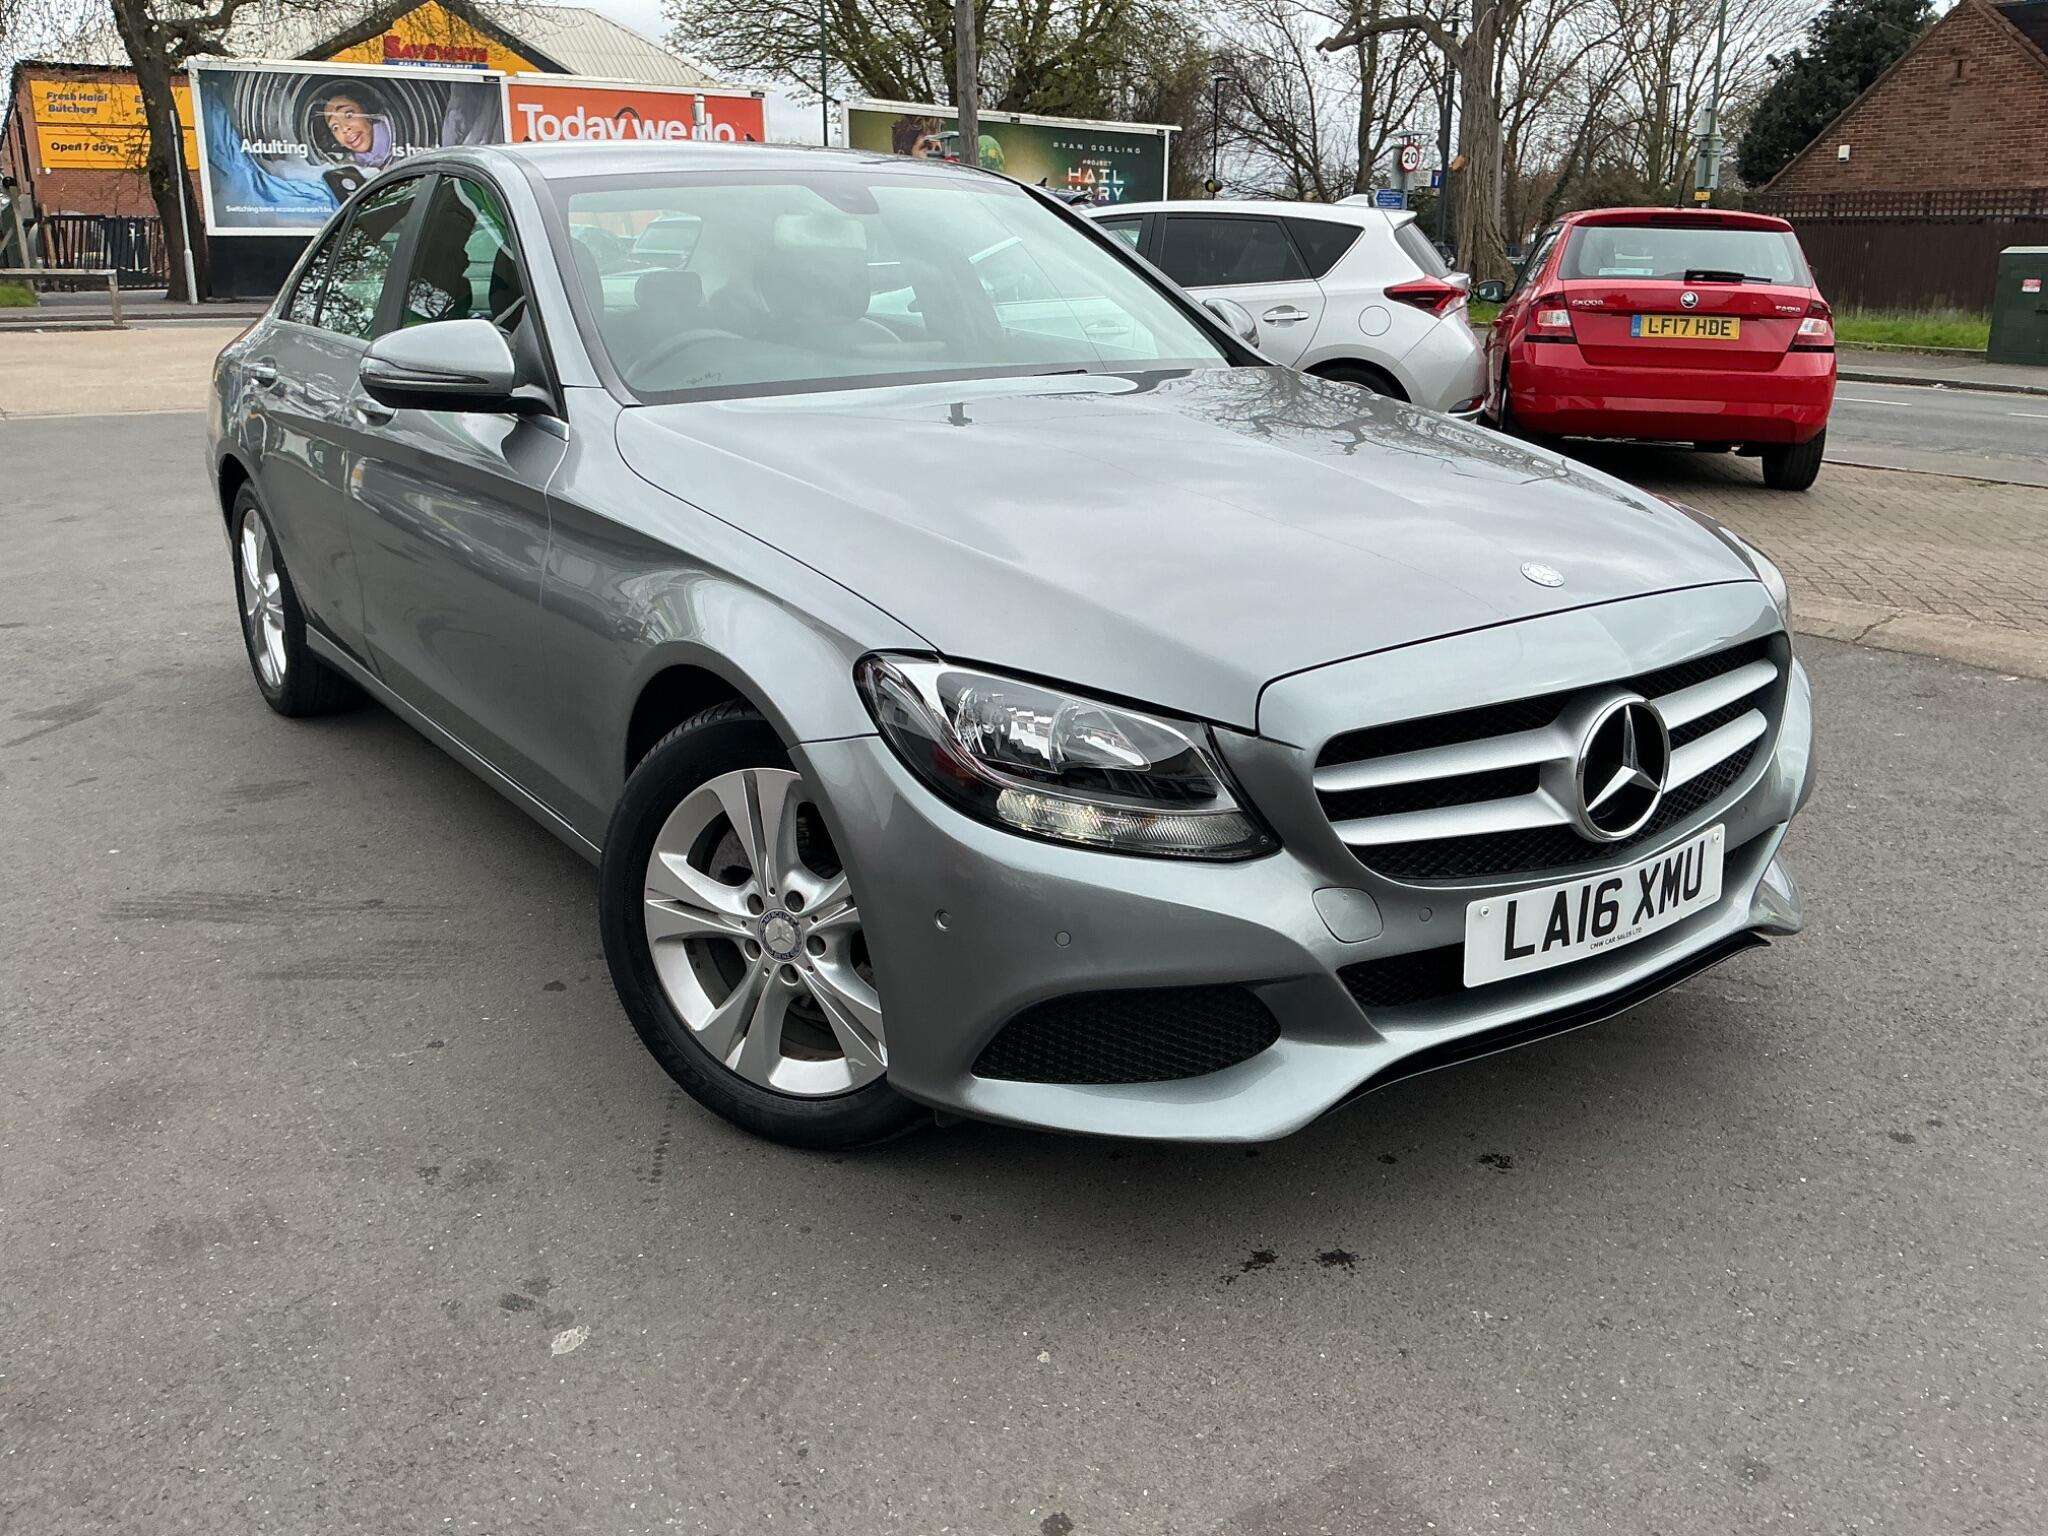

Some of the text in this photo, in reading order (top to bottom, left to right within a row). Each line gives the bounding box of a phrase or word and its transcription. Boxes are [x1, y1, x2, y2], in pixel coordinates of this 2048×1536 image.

[46, 91, 107, 102] Fresh Halal
[48, 104, 98, 114] Butchers
[517, 103, 628, 141] Today
[631, 118, 687, 141] we
[51, 142, 81, 152] Open
[83, 142, 89, 150] 7
[92, 143, 118, 154] days
[240, 138, 308, 159] Adulting
[392, 143, 405, 158] is
[1053, 142, 1141, 154] RYAN GOSLING
[1082, 159, 1112, 167] PROJECT
[1404, 152, 1417, 164] 20
[1068, 167, 1125, 184] HAIL
[1648, 318, 1690, 335] LF17
[1696, 319, 1732, 336] HDE
[1504, 841, 1705, 961] LA16 XMU
[1605, 936, 1617, 945] CAR
